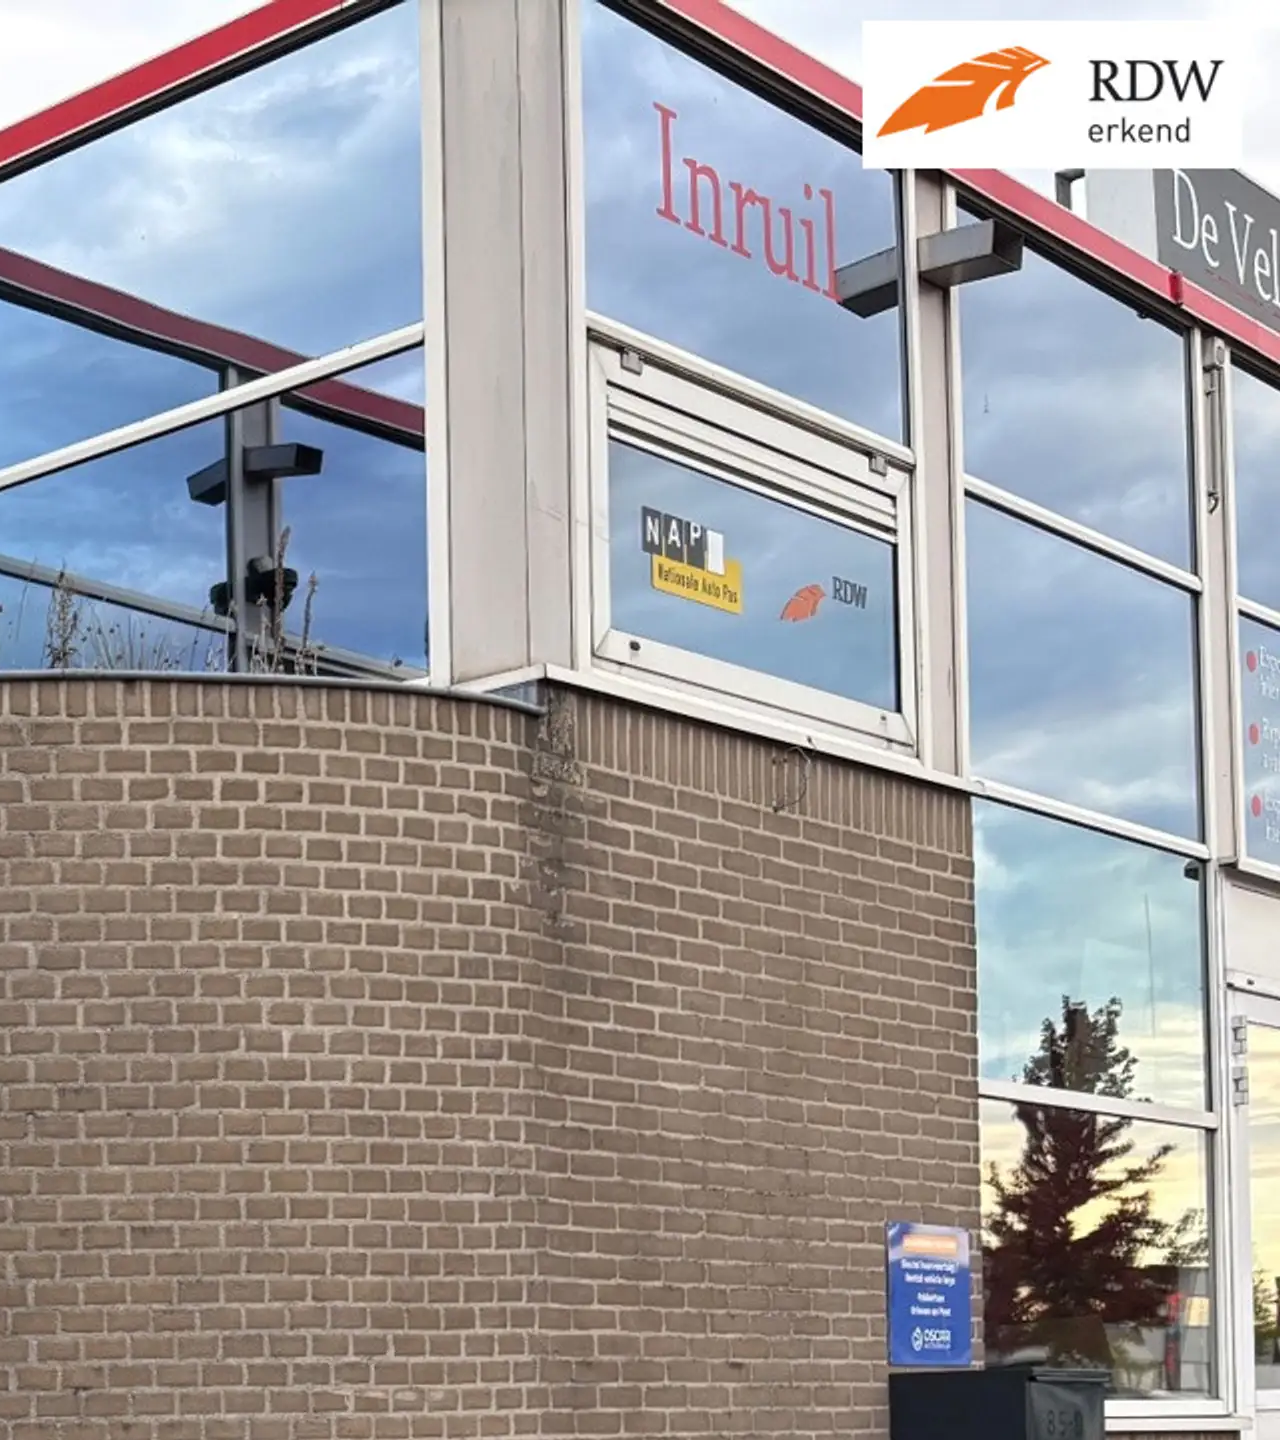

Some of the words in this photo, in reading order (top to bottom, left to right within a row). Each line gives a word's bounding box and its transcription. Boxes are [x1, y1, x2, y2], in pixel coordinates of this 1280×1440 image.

[653, 102, 841, 302] Inruil
[1173, 169, 1219, 267] De
[646, 516, 702, 547] NAP
[832, 576, 868, 610] RDW
